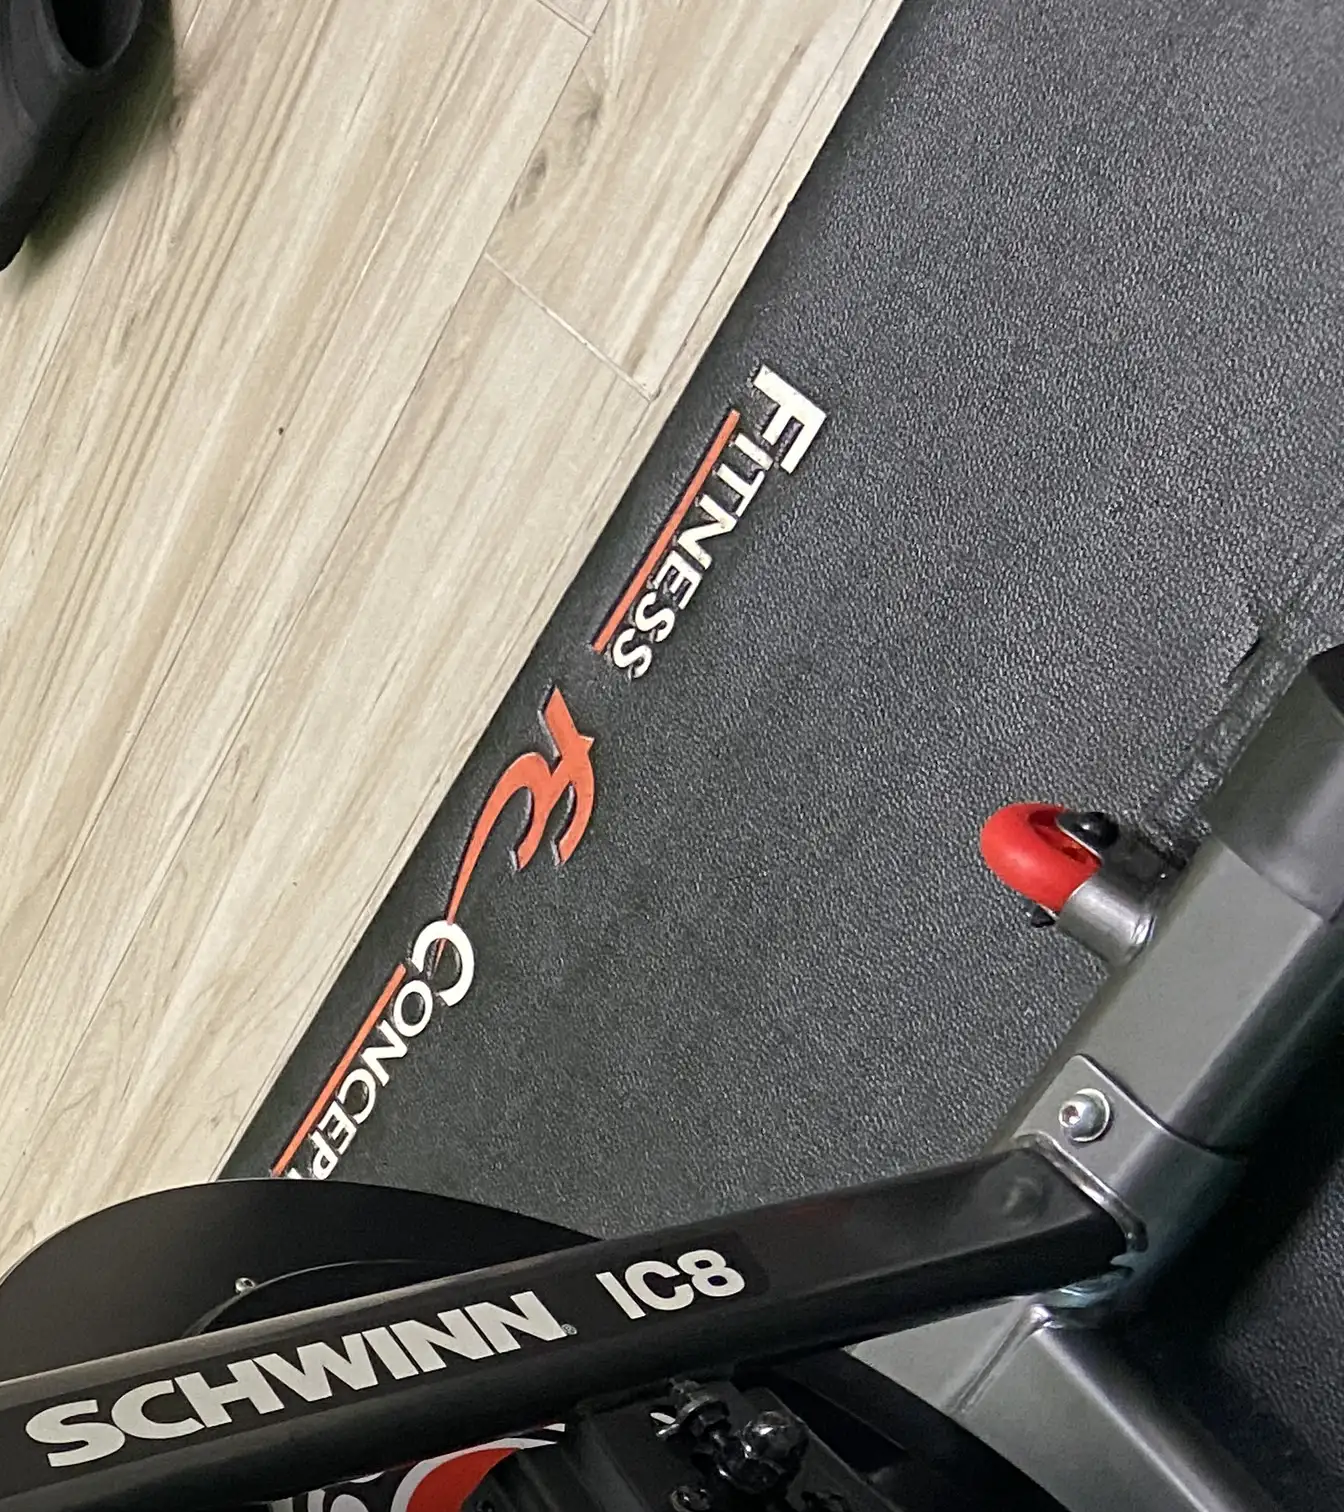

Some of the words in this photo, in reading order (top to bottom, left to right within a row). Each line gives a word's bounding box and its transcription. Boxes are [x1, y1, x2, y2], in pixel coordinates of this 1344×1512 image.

[612, 364, 827, 678] FITNESS
[287, 918, 475, 1181] CONCEP
[595, 1249, 745, 1320] IC8
